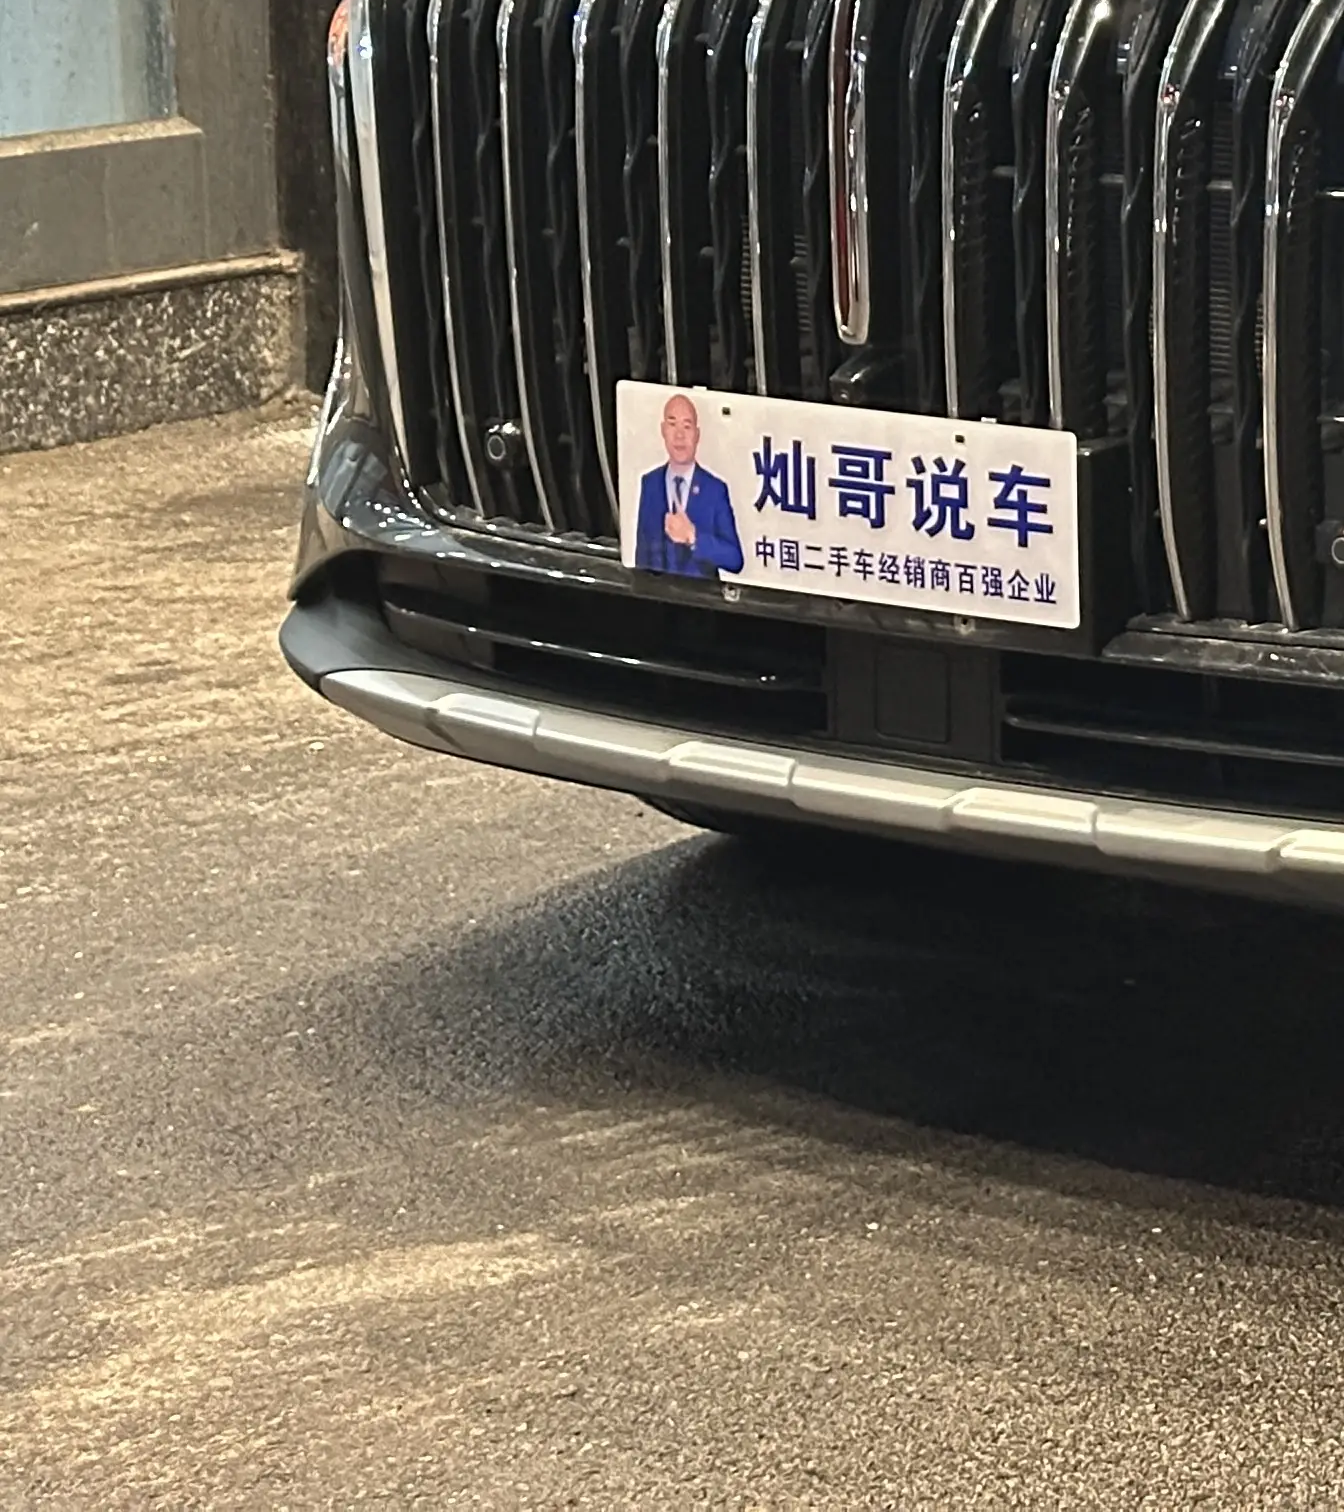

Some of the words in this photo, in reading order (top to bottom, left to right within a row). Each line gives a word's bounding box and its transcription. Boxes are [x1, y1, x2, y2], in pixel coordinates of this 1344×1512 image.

[753, 436, 1053, 548] 灿哥说车
[755, 535, 1058, 605] 中国二手车经销商百强企业
